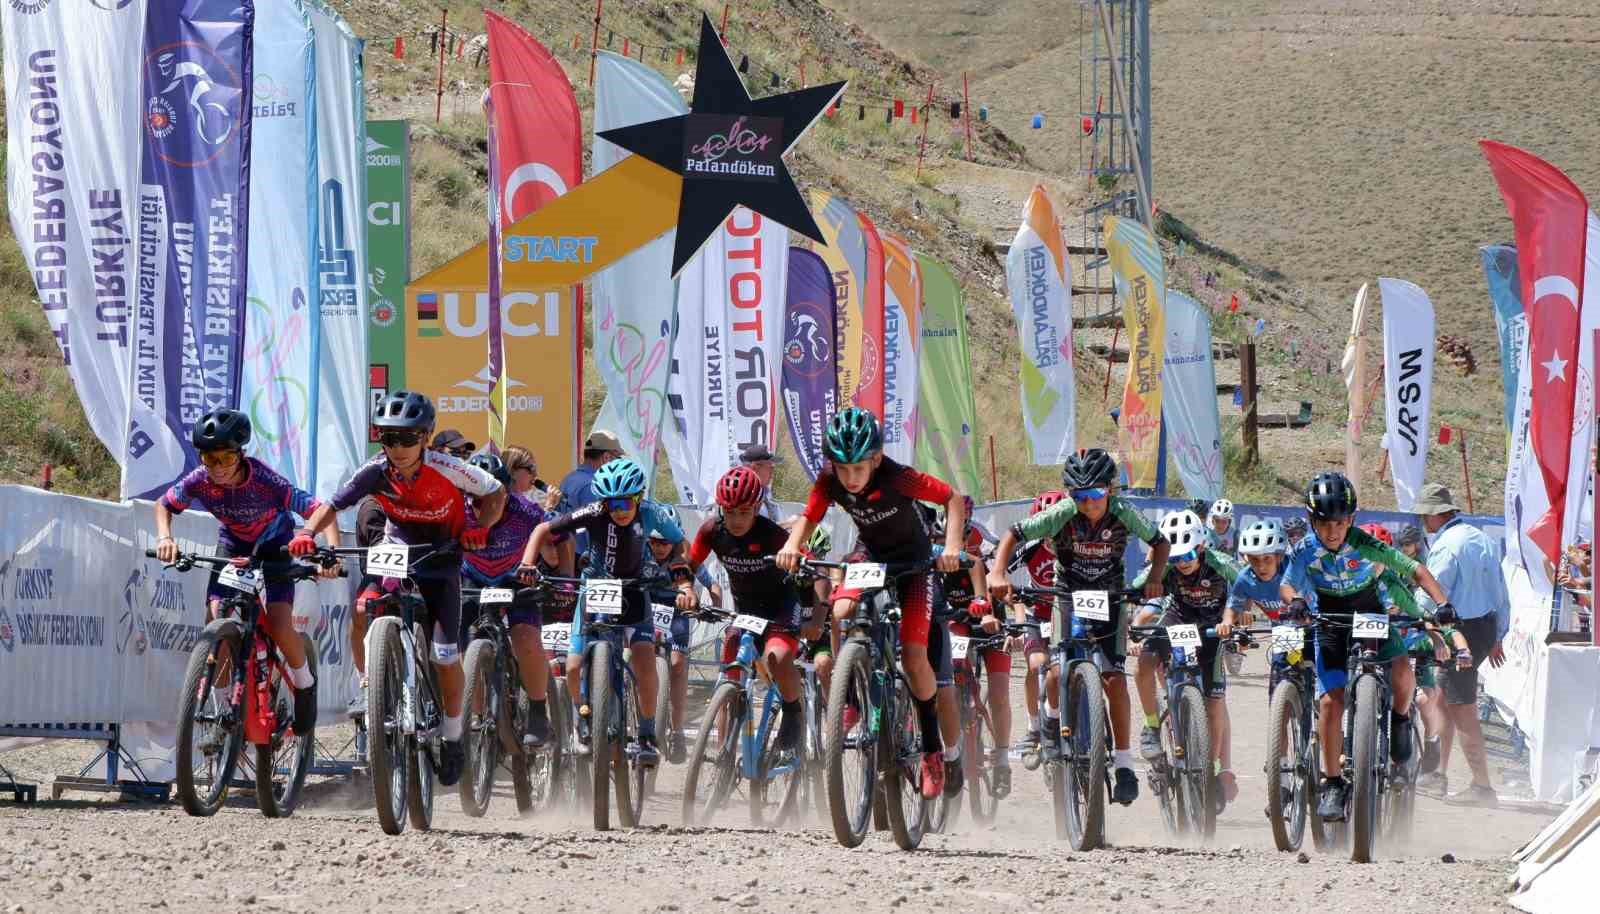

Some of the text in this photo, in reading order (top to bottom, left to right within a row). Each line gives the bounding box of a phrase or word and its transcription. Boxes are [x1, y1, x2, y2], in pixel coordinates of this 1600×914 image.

[687, 158, 775, 176] Palandöken
[367, 201, 401, 226] CI
[505, 235, 598, 263] START
[444, 291, 560, 337] UCI
[1397, 347, 1424, 457] JRSW
[370, 552, 405, 567] 272
[848, 569, 881, 580] 274
[588, 590, 618, 602] 277
[1075, 597, 1105, 610] 267
[654, 611, 671, 624] 70
[50, 613, 105, 648] FEDERASYONU
[1355, 620, 1386, 631] 260
[543, 630, 569, 641] 273
[1171, 630, 1198, 640] 268
[951, 642, 967, 652] 76
